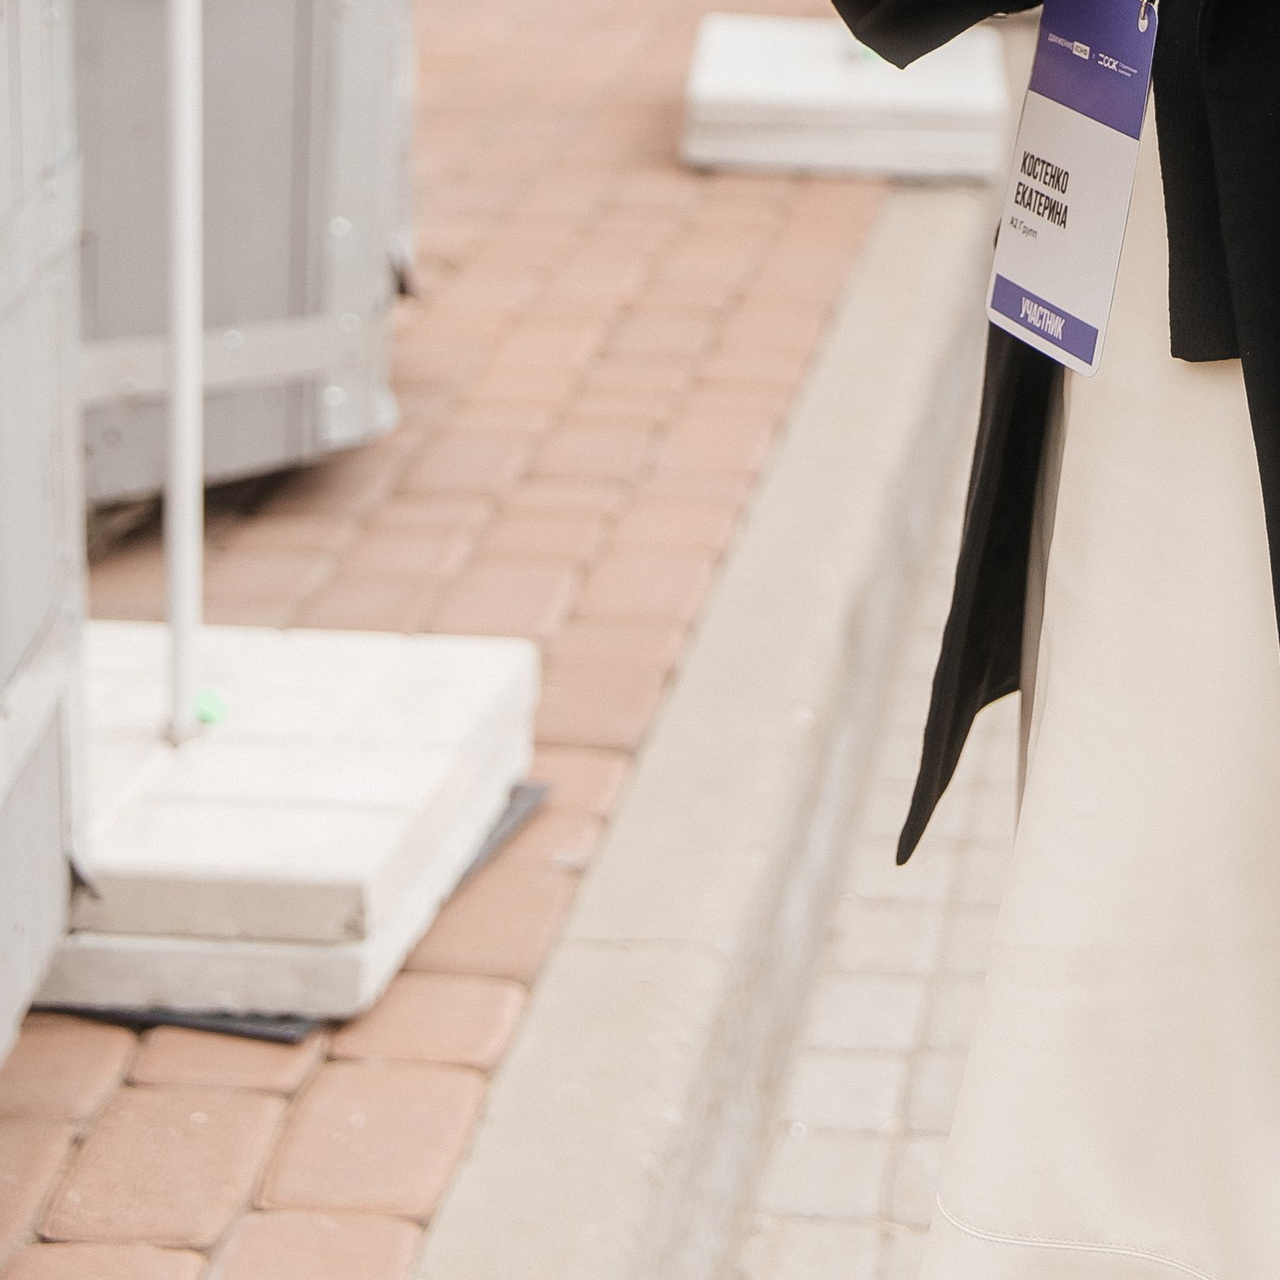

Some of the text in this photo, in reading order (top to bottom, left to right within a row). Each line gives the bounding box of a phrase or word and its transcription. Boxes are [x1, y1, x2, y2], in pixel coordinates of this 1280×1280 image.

[1020, 151, 1070, 195] КОСТЕНКО
[1014, 182, 1069, 230] ЕКАТЕРИНА
[1019, 297, 1065, 341] УЧАСТНИК
